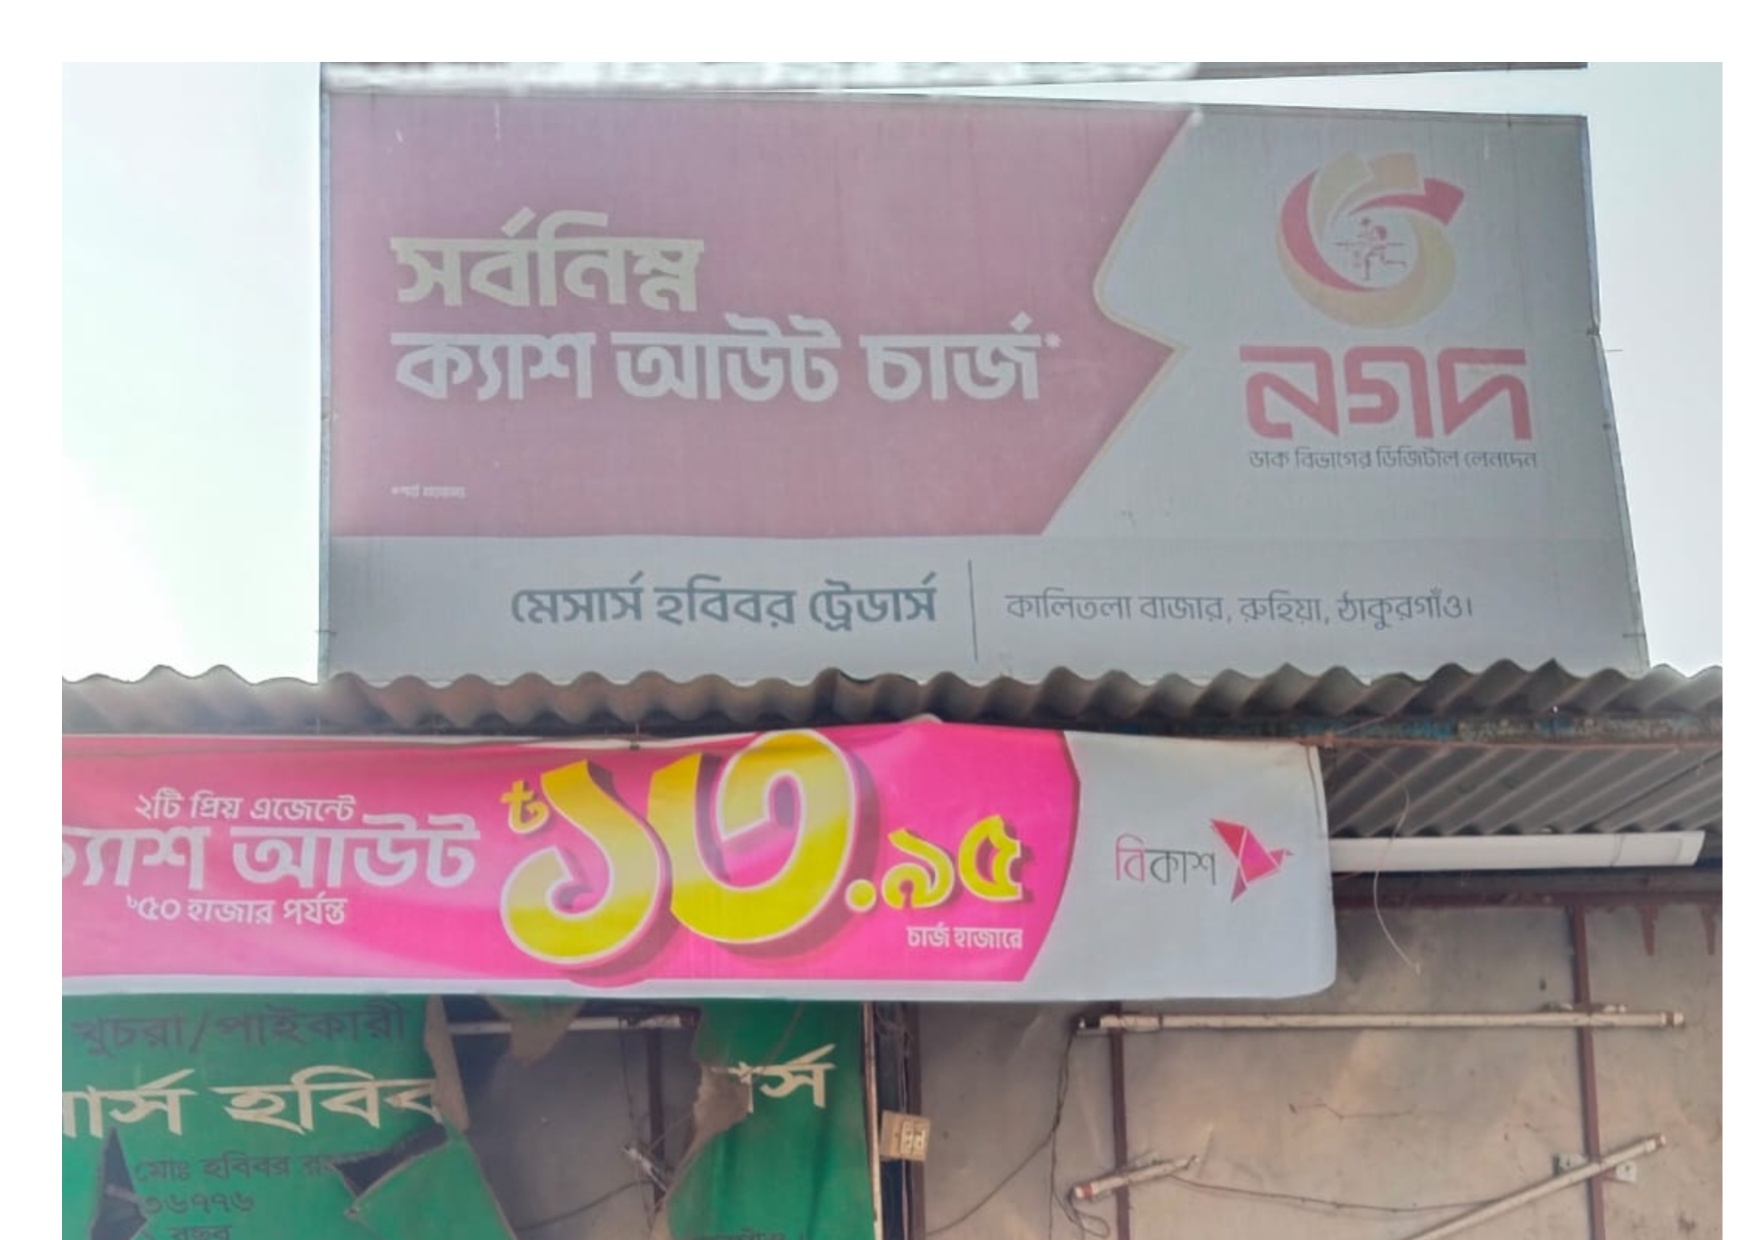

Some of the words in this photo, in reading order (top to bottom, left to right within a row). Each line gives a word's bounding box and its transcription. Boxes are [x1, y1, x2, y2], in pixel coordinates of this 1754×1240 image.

[391, 206, 704, 313] সর্বনিম্ন
[391, 332, 596, 401] ক্যাশ
[611, 312, 841, 402] আউট
[1240, 346, 1533, 441] নগদ
[1248, 450, 1291, 470] ডাক
[1294, 446, 1373, 470] বিভাগের
[1375, 445, 1460, 470] ডিজিটাল
[1463, 448, 1538, 470] লেনদেন
[511, 572, 643, 625] মেসার্স
[654, 575, 797, 628] হবিবর
[809, 572, 937, 632] ট্রেডার্স
[1006, 587, 1132, 622] কালিতলা
[1140, 593, 1234, 625] বাজার,
[135, 787, 184, 820] ২টি
[189, 789, 240, 820] প্রিয়
[249, 793, 357, 822] এজেন্টে
[230, 813, 482, 891] আউট
[1114, 834, 1217, 886] বিকাশ
[187, 896, 274, 925] হাজার
[282, 894, 349, 926] পর্যন্ত
[906, 921, 950, 950] চার্জ
[954, 927, 1024, 950] হাজারে
